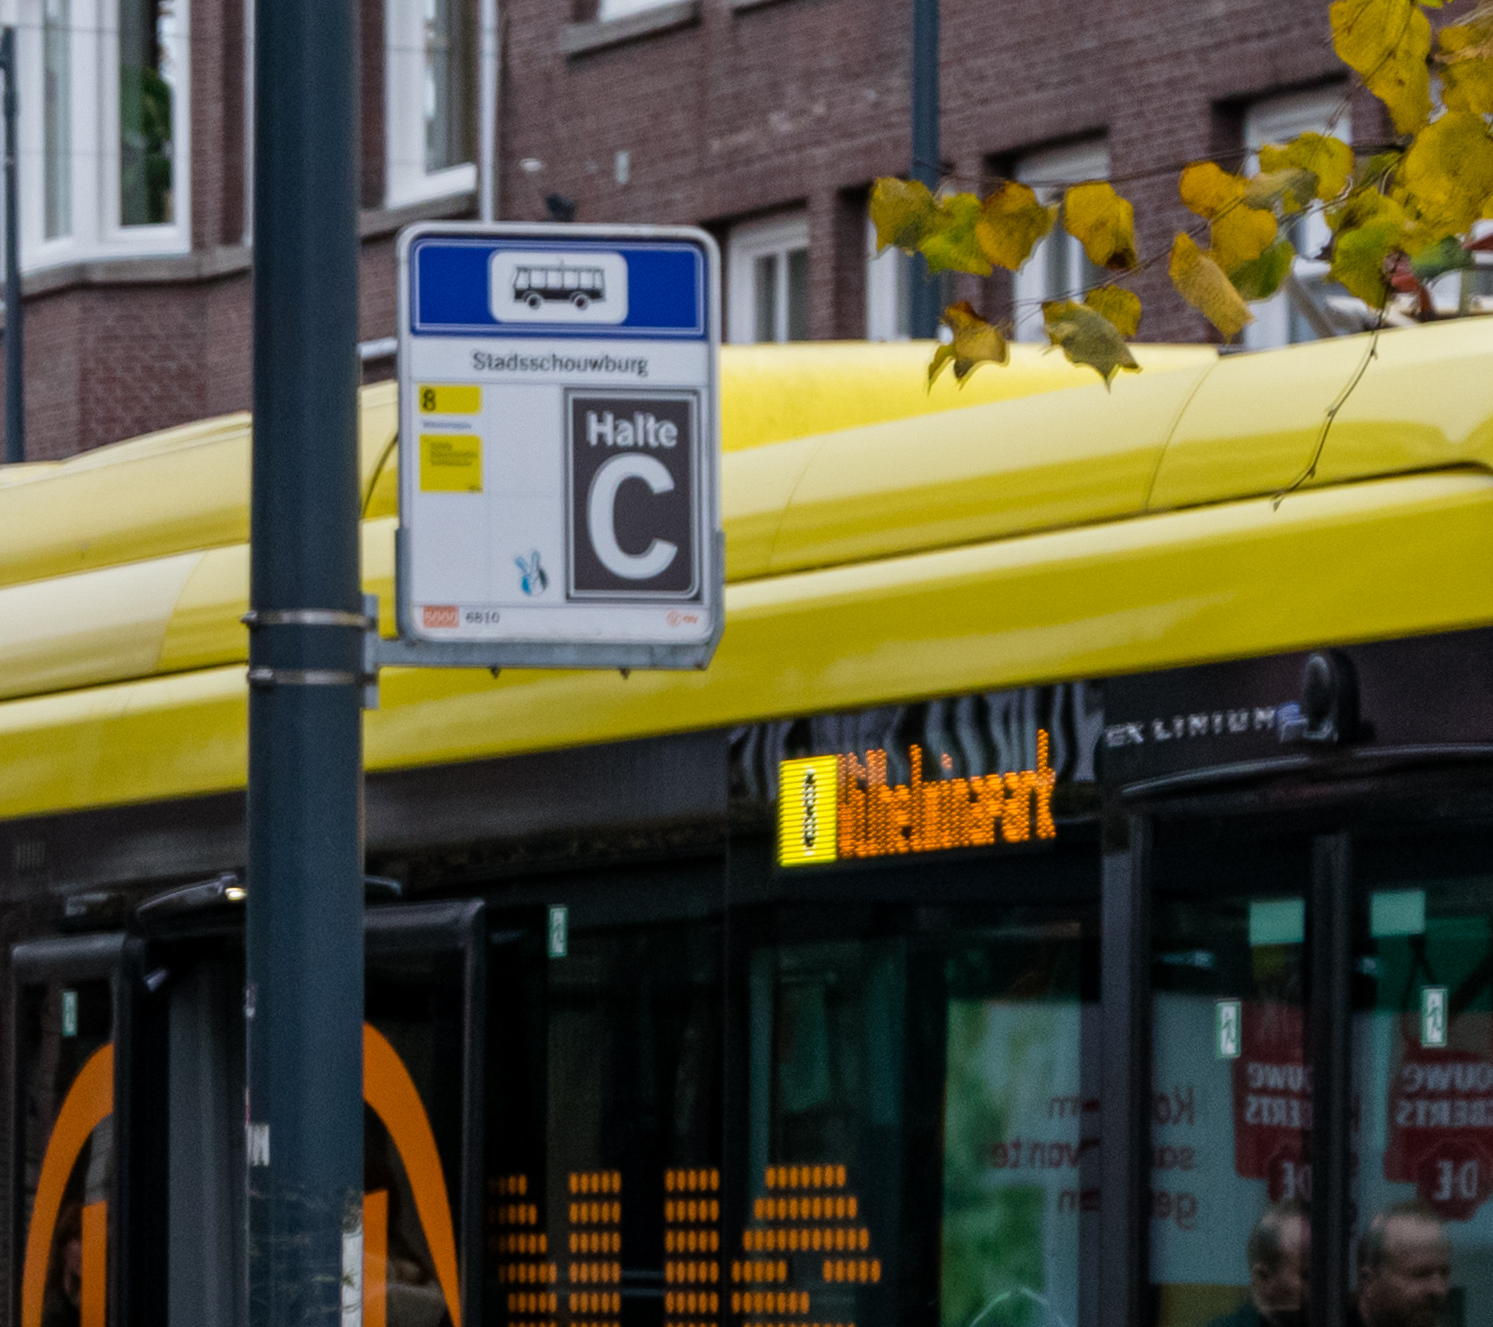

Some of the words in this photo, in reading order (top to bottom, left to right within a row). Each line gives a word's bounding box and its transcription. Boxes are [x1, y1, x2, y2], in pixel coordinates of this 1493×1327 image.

[472, 350, 649, 377] Stadsschouwburg
[422, 388, 436, 412] 8
[587, 411, 678, 449] Halte
[587, 452, 678, 580] C
